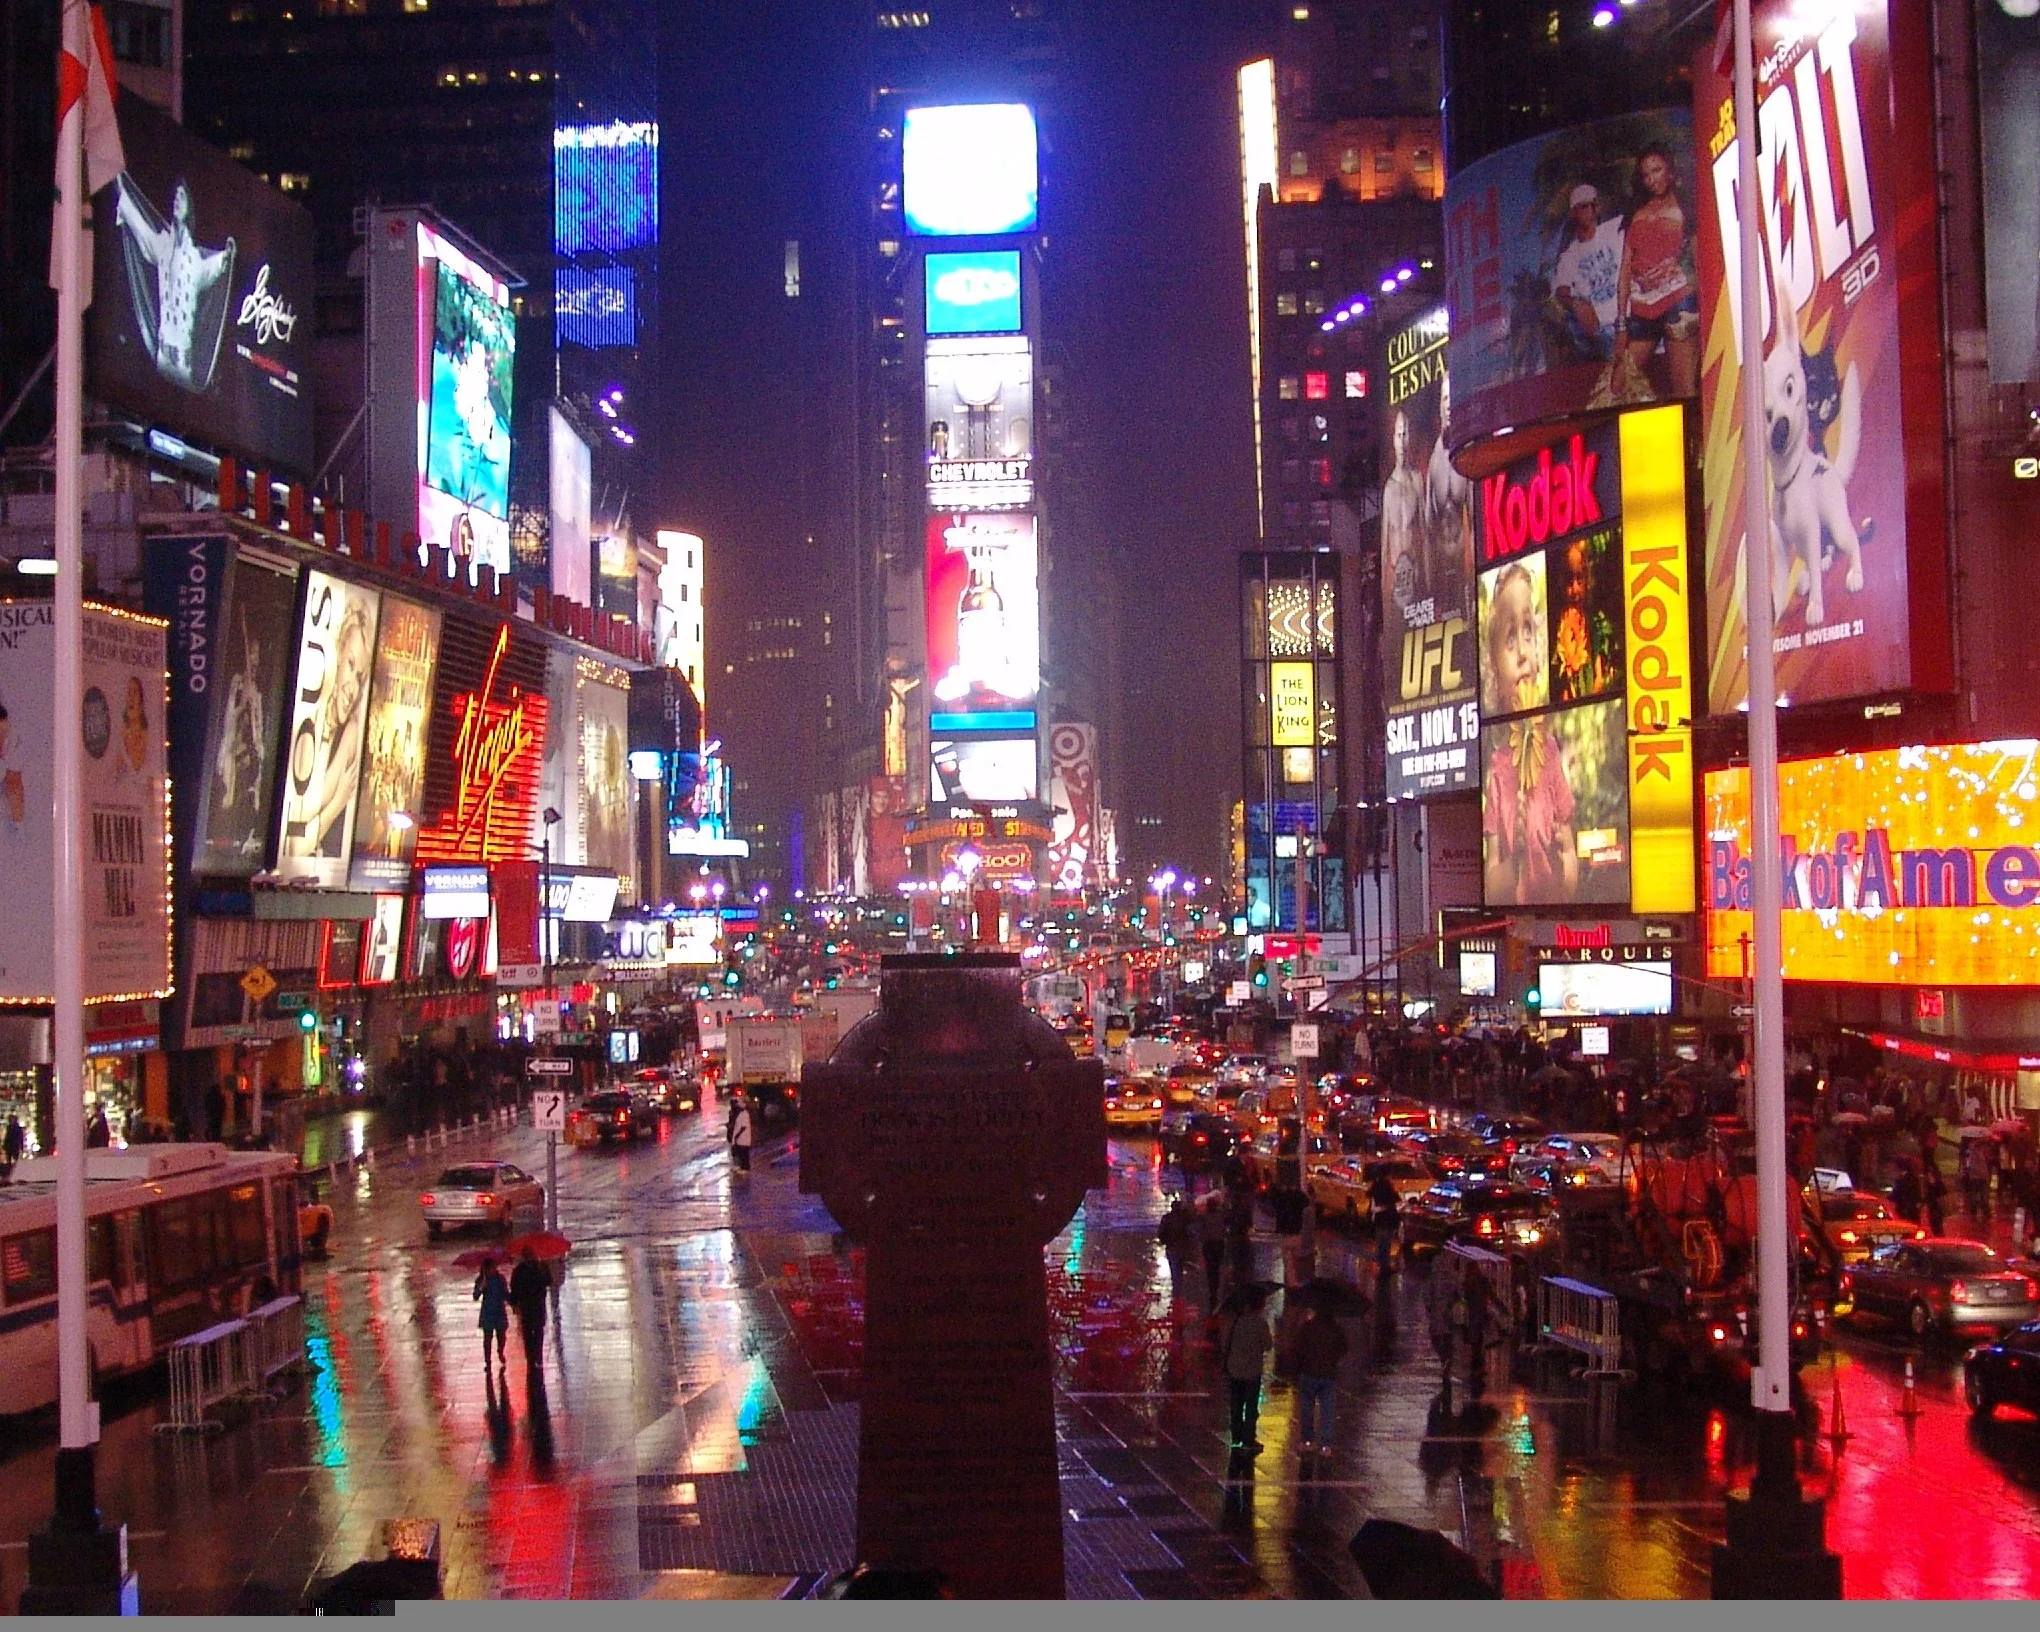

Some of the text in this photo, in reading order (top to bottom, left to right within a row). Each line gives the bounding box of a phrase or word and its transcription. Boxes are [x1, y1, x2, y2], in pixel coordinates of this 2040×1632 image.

[1841, 254, 1880, 305] 3D
[930, 461, 1028, 482] CHEVROLET
[1484, 434, 1601, 560] Kodak
[0, 606, 55, 628] SICAL
[189, 542, 206, 693] VORNADO
[1805, 622, 1850, 646] NOVEMBER
[1853, 618, 1864, 635] 21
[1401, 617, 1463, 700] UFC
[1630, 545, 1684, 784] Kodak
[1281, 679, 1303, 690] THE
[1277, 694, 1308, 712] LION
[1277, 715, 1309, 734] KING
[1387, 701, 1479, 755] SAT, NOV. 15
[92, 813, 144, 864] MAMMA
[425, 874, 487, 887] VORNADO
[1710, 835, 1808, 909] Bak
[1556, 924, 1611, 947] Marriott
[1538, 947, 1673, 962] MARQUIS
[1300, 1029, 1311, 1039] NO
[1294, 1041, 1316, 1050] TURNS
[537, 1096, 551, 1104] NO
[539, 1119, 561, 1127] TURN
